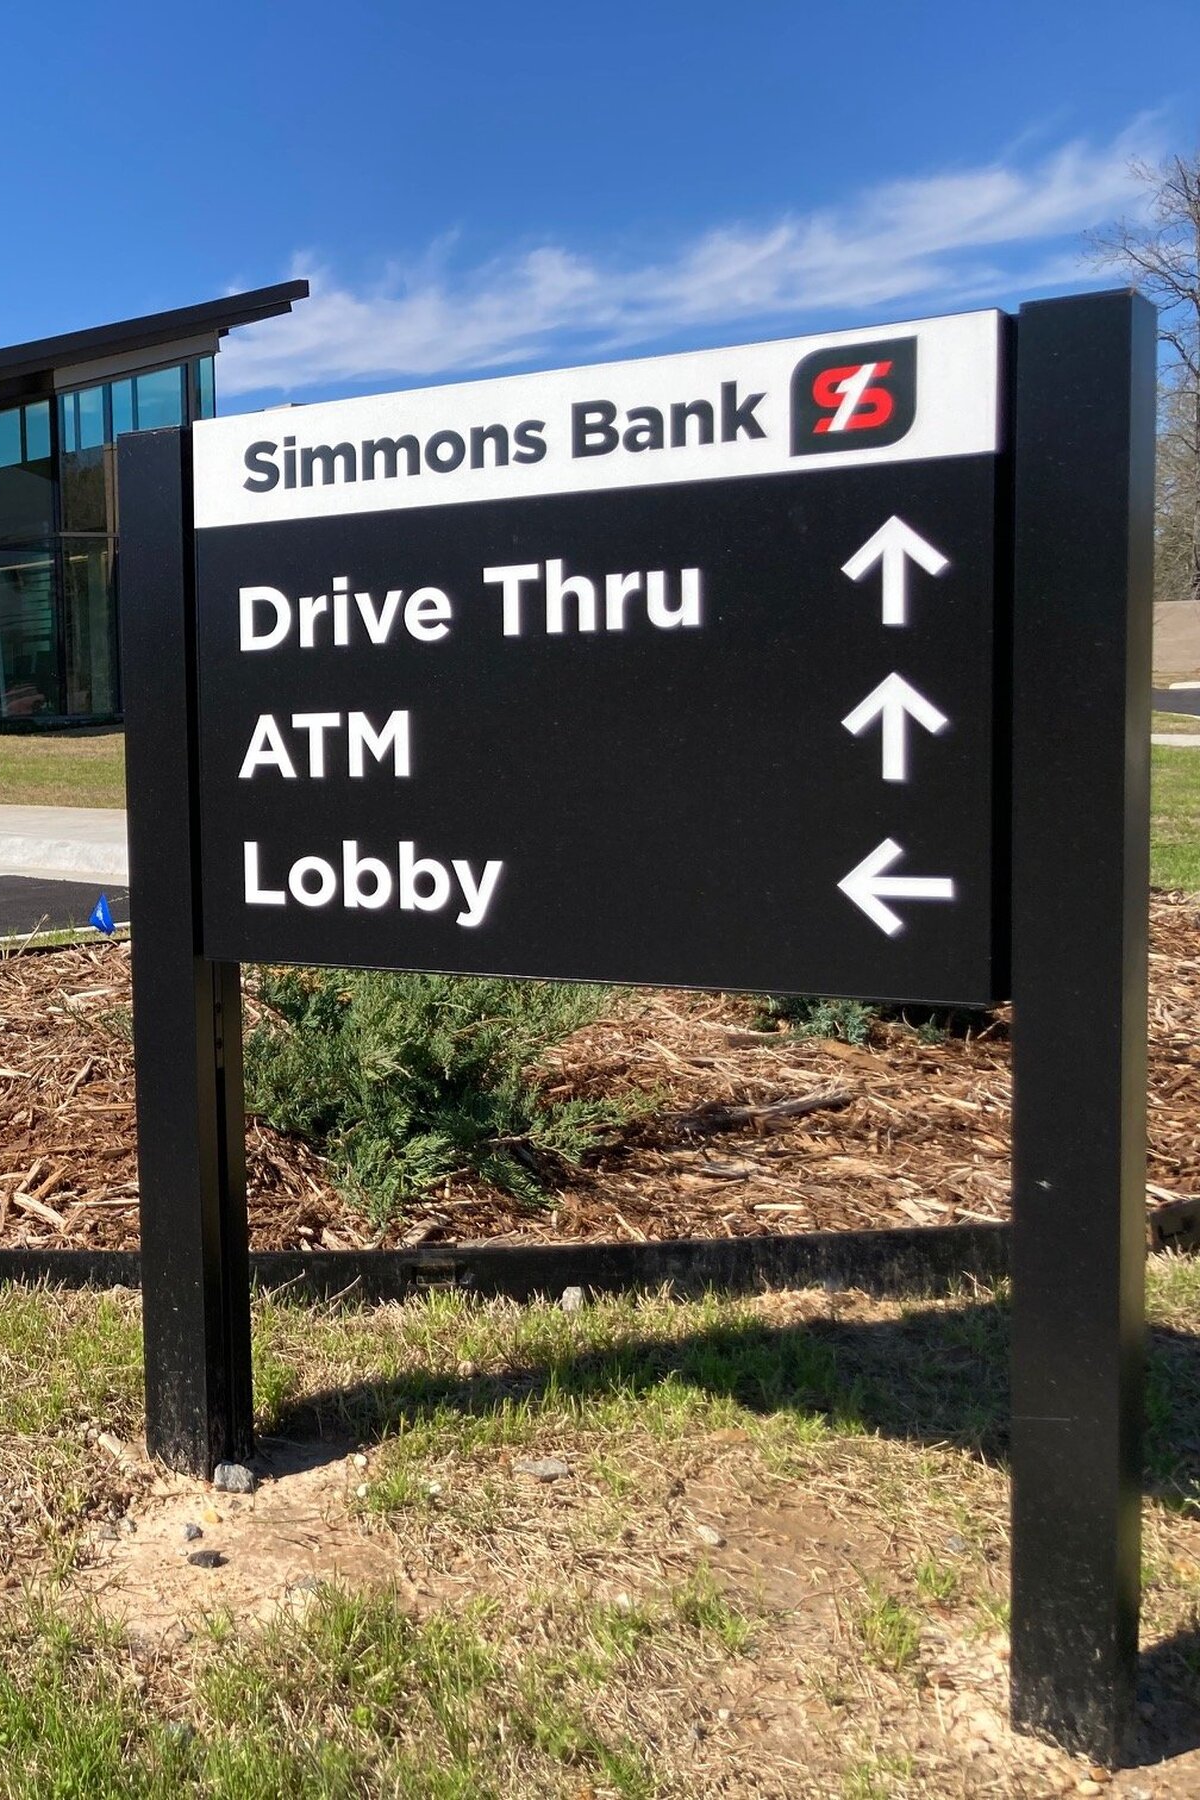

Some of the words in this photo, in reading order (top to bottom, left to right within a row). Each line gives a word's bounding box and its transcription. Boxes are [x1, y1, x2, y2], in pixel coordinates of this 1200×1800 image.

[243, 419, 548, 494] Simmons
[571, 380, 768, 459] Bank
[238, 575, 454, 652] Drive
[483, 558, 701, 637] Thru
[237, 709, 412, 779] ATM
[243, 839, 504, 928] Lobby
